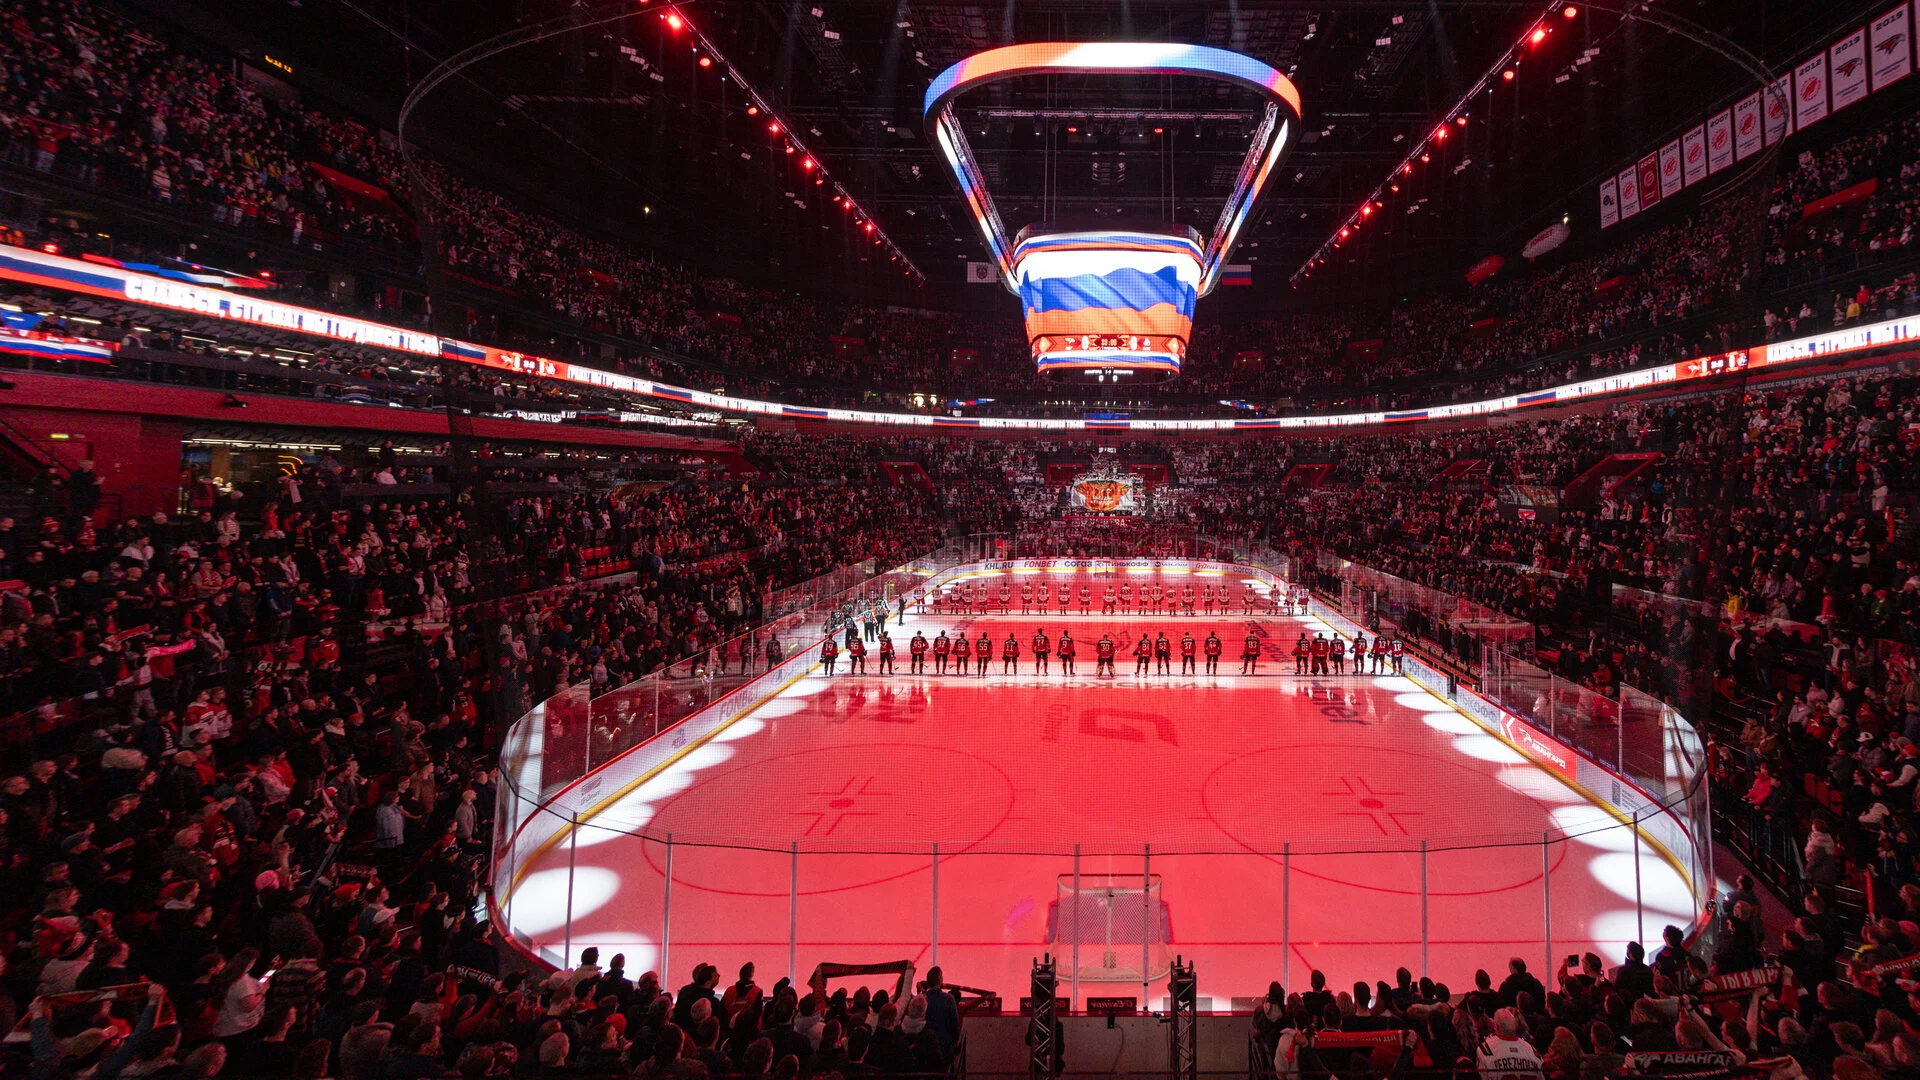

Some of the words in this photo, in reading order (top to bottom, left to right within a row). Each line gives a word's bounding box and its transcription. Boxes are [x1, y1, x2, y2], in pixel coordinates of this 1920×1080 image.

[1875, 10, 1904, 31] 2019
[1834, 35, 1861, 55] 2019
[1798, 58, 1823, 76] 2012
[1709, 113, 1729, 128] 2007
[1024, 560, 1058, 569] FONBET
[1531, 743, 1567, 770] АВАНГАРД
[1663, 1053, 1733, 1068] АВАНГАР
